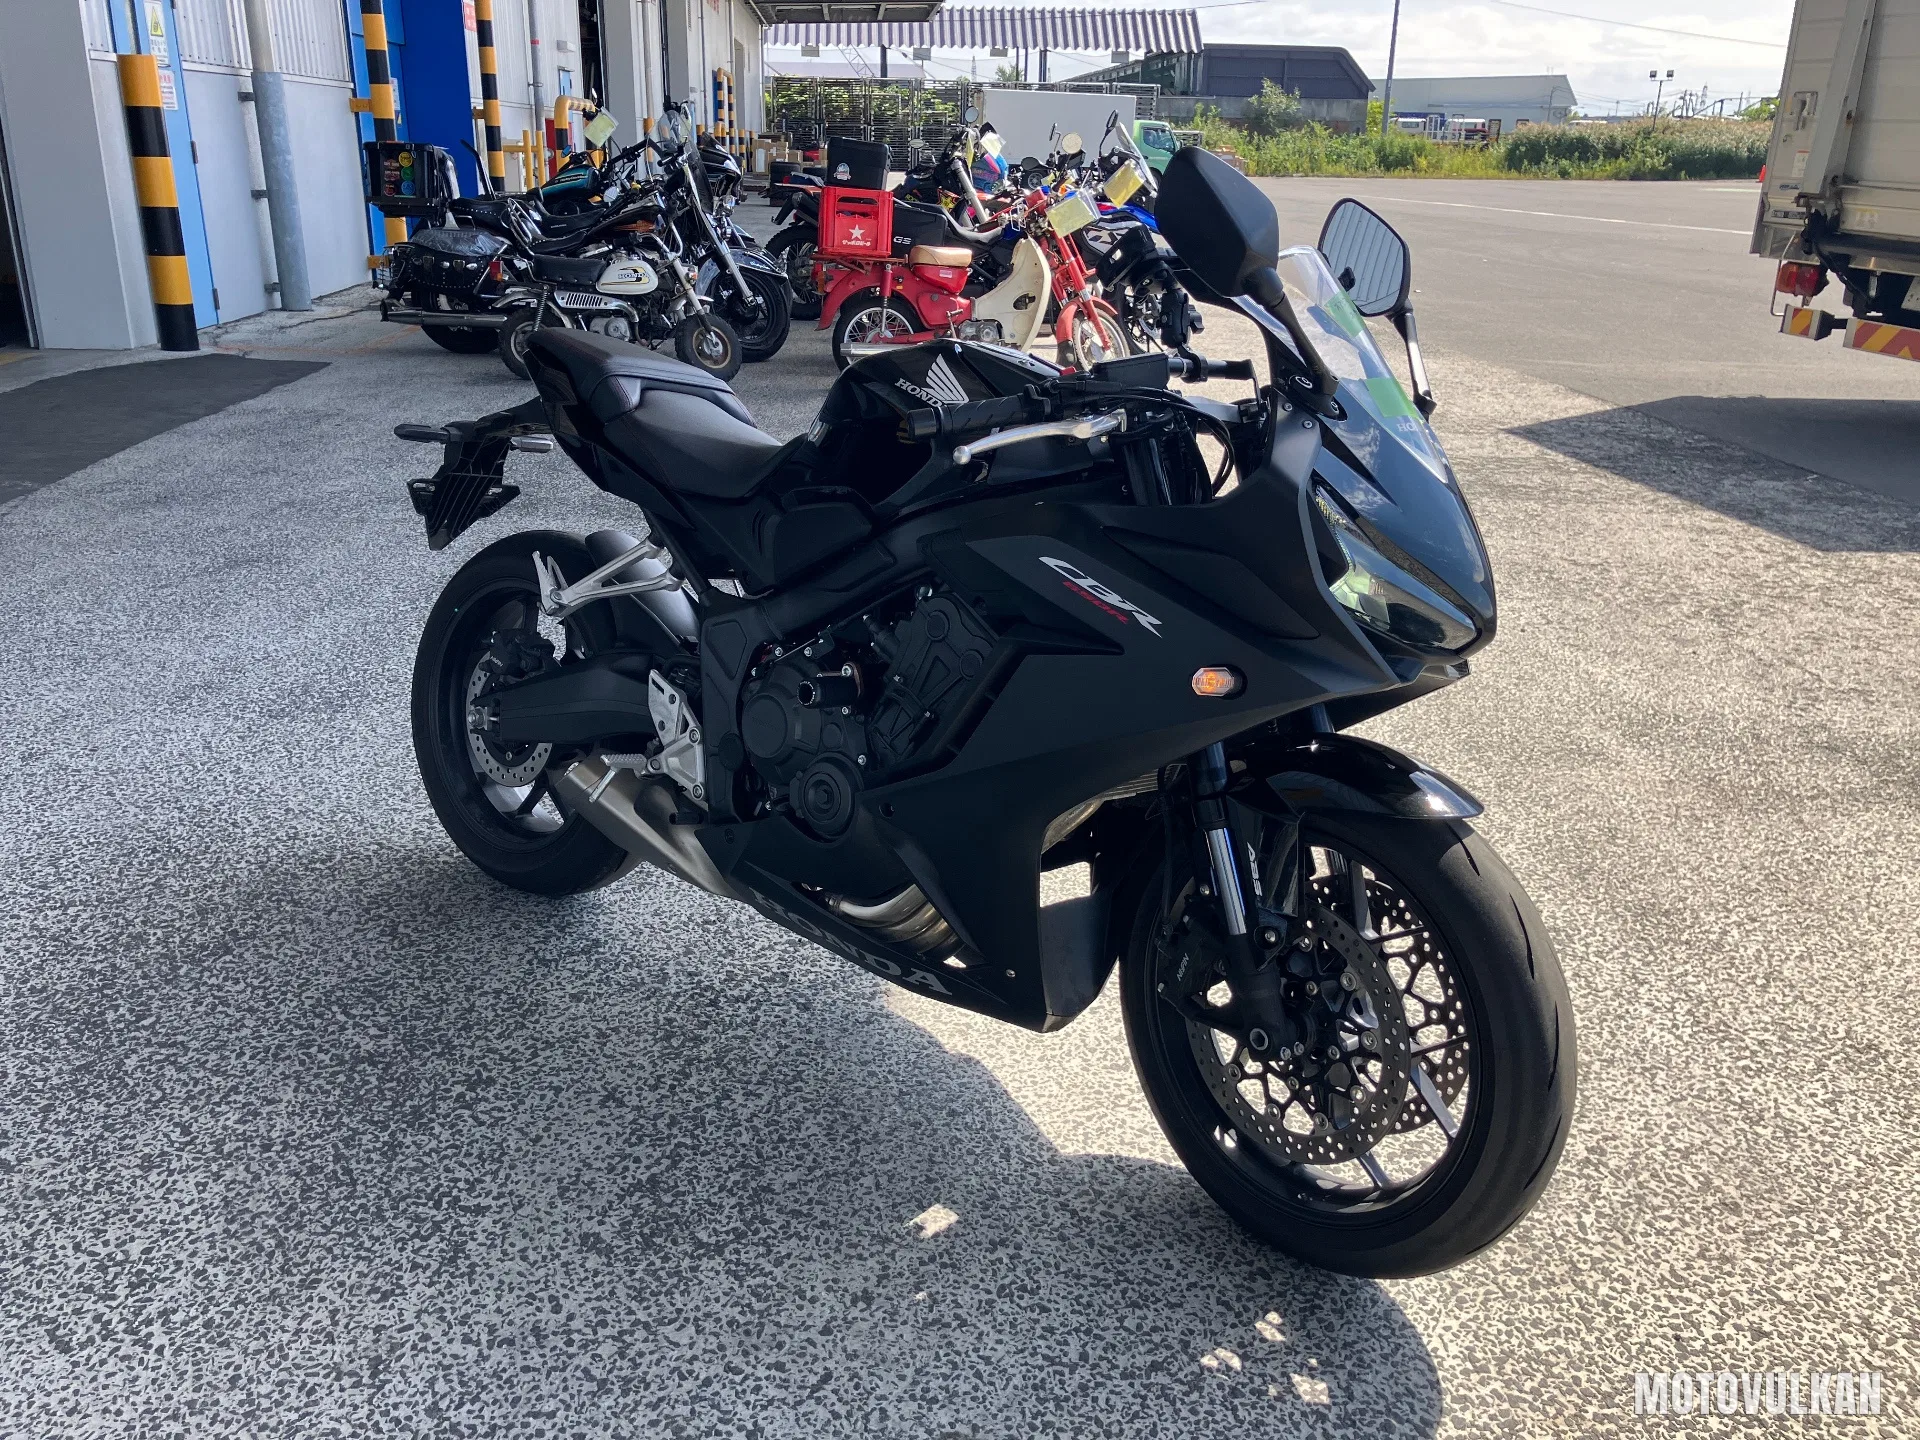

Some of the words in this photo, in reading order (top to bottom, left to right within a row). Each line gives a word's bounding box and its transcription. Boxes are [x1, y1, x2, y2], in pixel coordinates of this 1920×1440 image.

[893, 236, 912, 245] GS
[894, 377, 948, 408] HOND
[1038, 556, 1162, 638] CBR
[1247, 842, 1263, 896] ABS
[749, 886, 953, 996] HONDA
